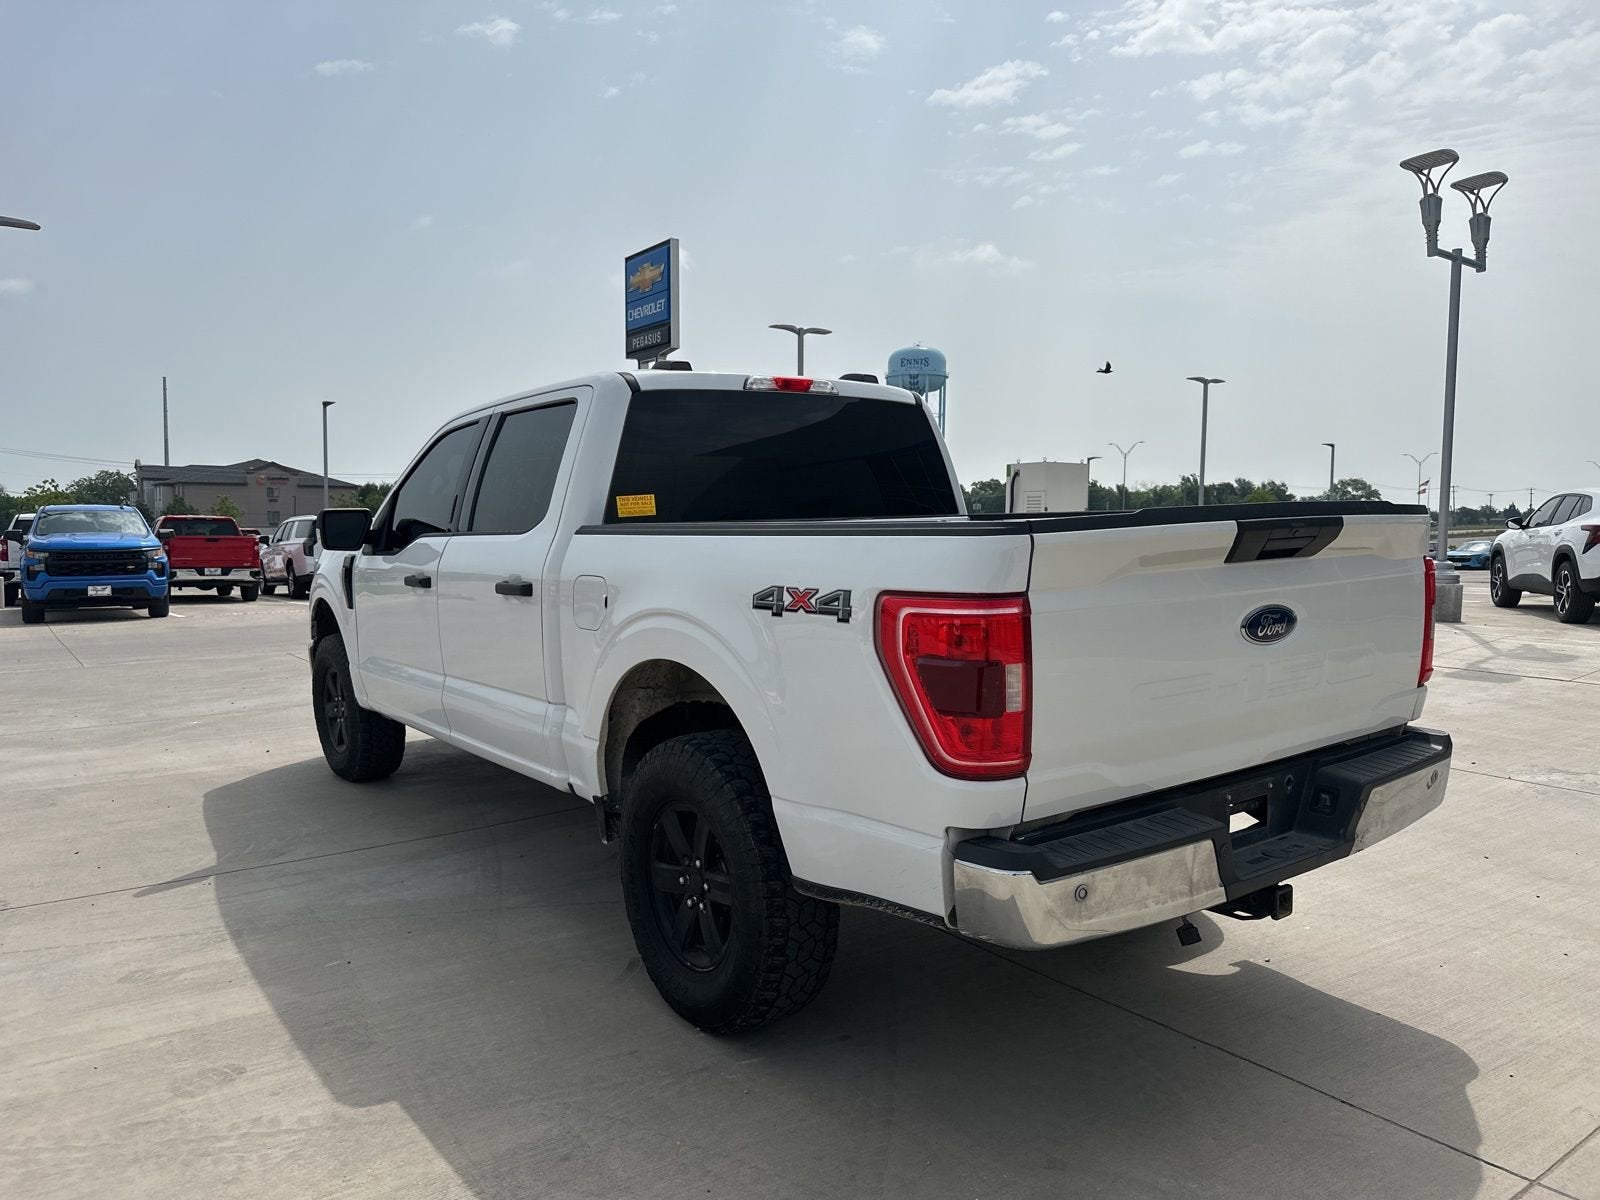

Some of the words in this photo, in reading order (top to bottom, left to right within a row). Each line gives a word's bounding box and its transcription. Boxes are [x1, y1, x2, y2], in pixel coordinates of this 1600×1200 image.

[628, 299, 666, 321] CHEVROLET
[632, 331, 662, 349] PEGASUS
[900, 357, 930, 368] ENNIS
[1257, 613, 1288, 637] Ford
